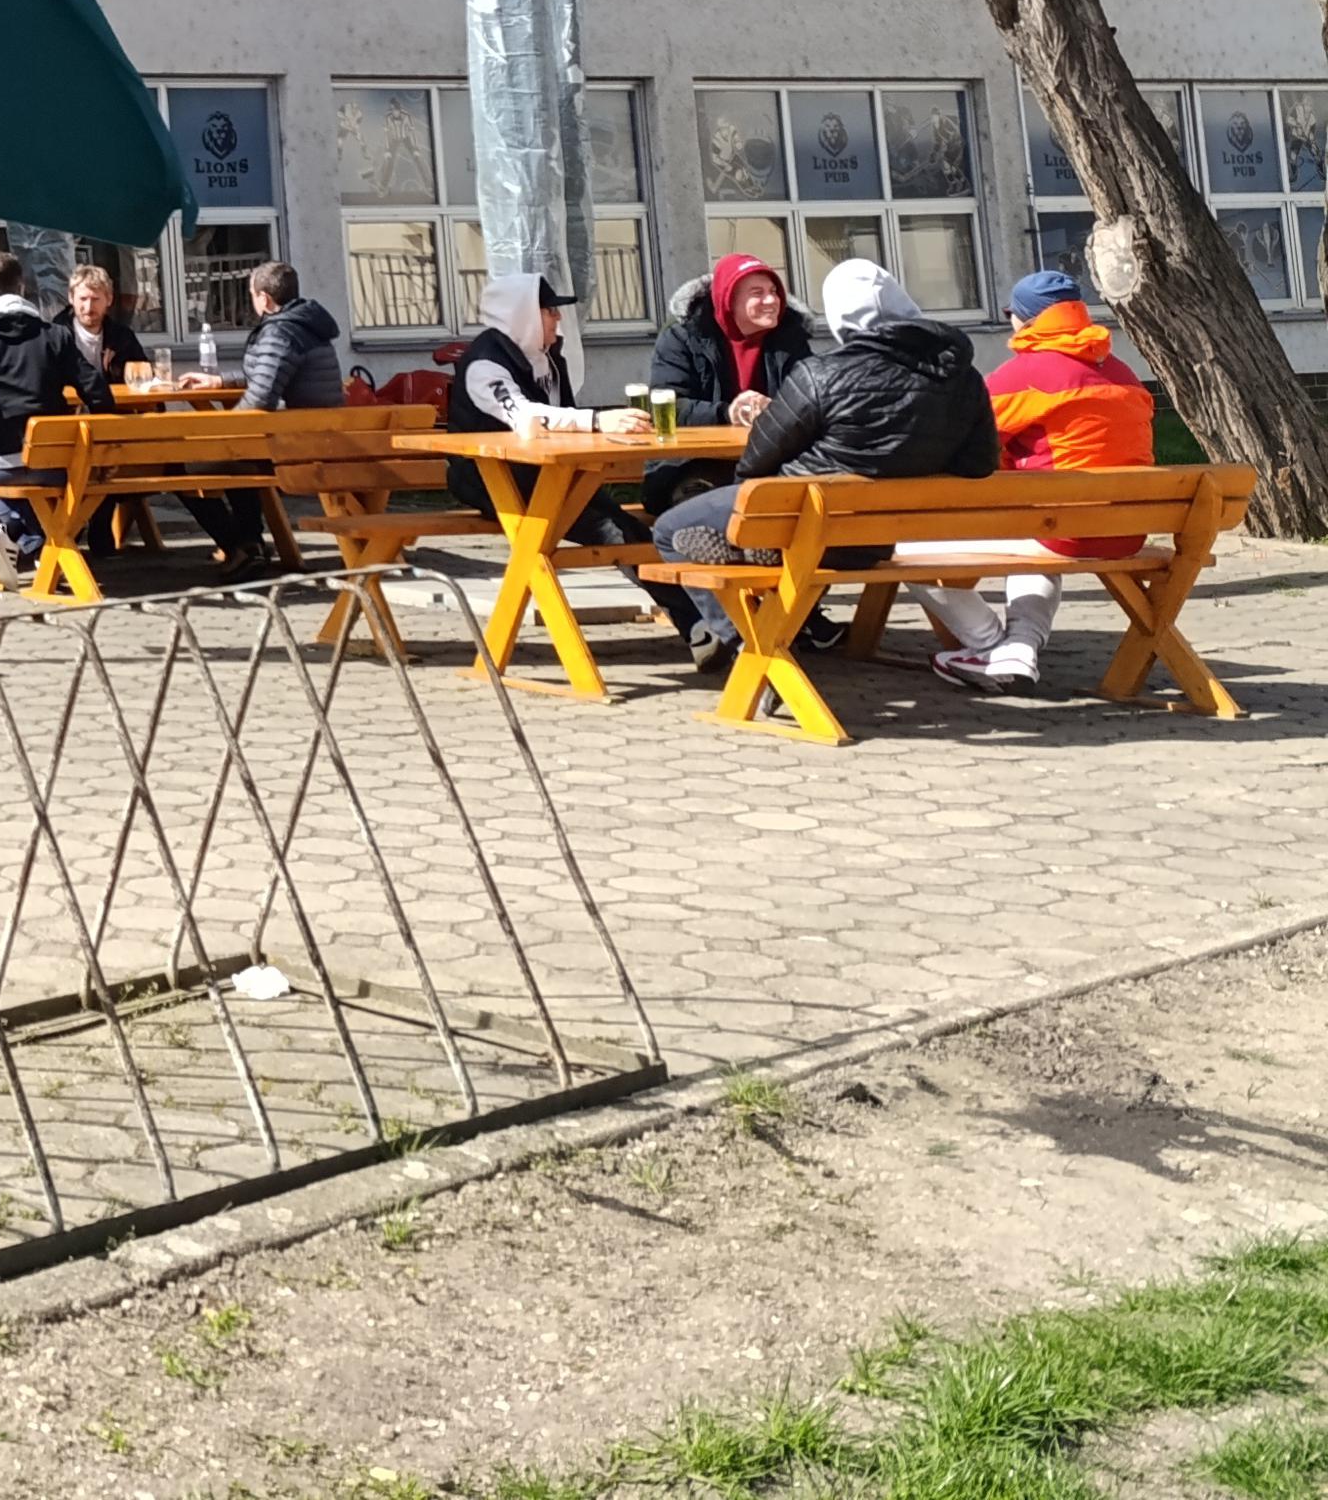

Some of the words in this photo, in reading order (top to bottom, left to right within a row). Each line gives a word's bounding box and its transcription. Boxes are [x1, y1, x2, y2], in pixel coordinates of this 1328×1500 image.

[824, 171, 850, 183] PUB
[1232, 166, 1256, 177] PUB
[207, 175, 238, 188] PUB
